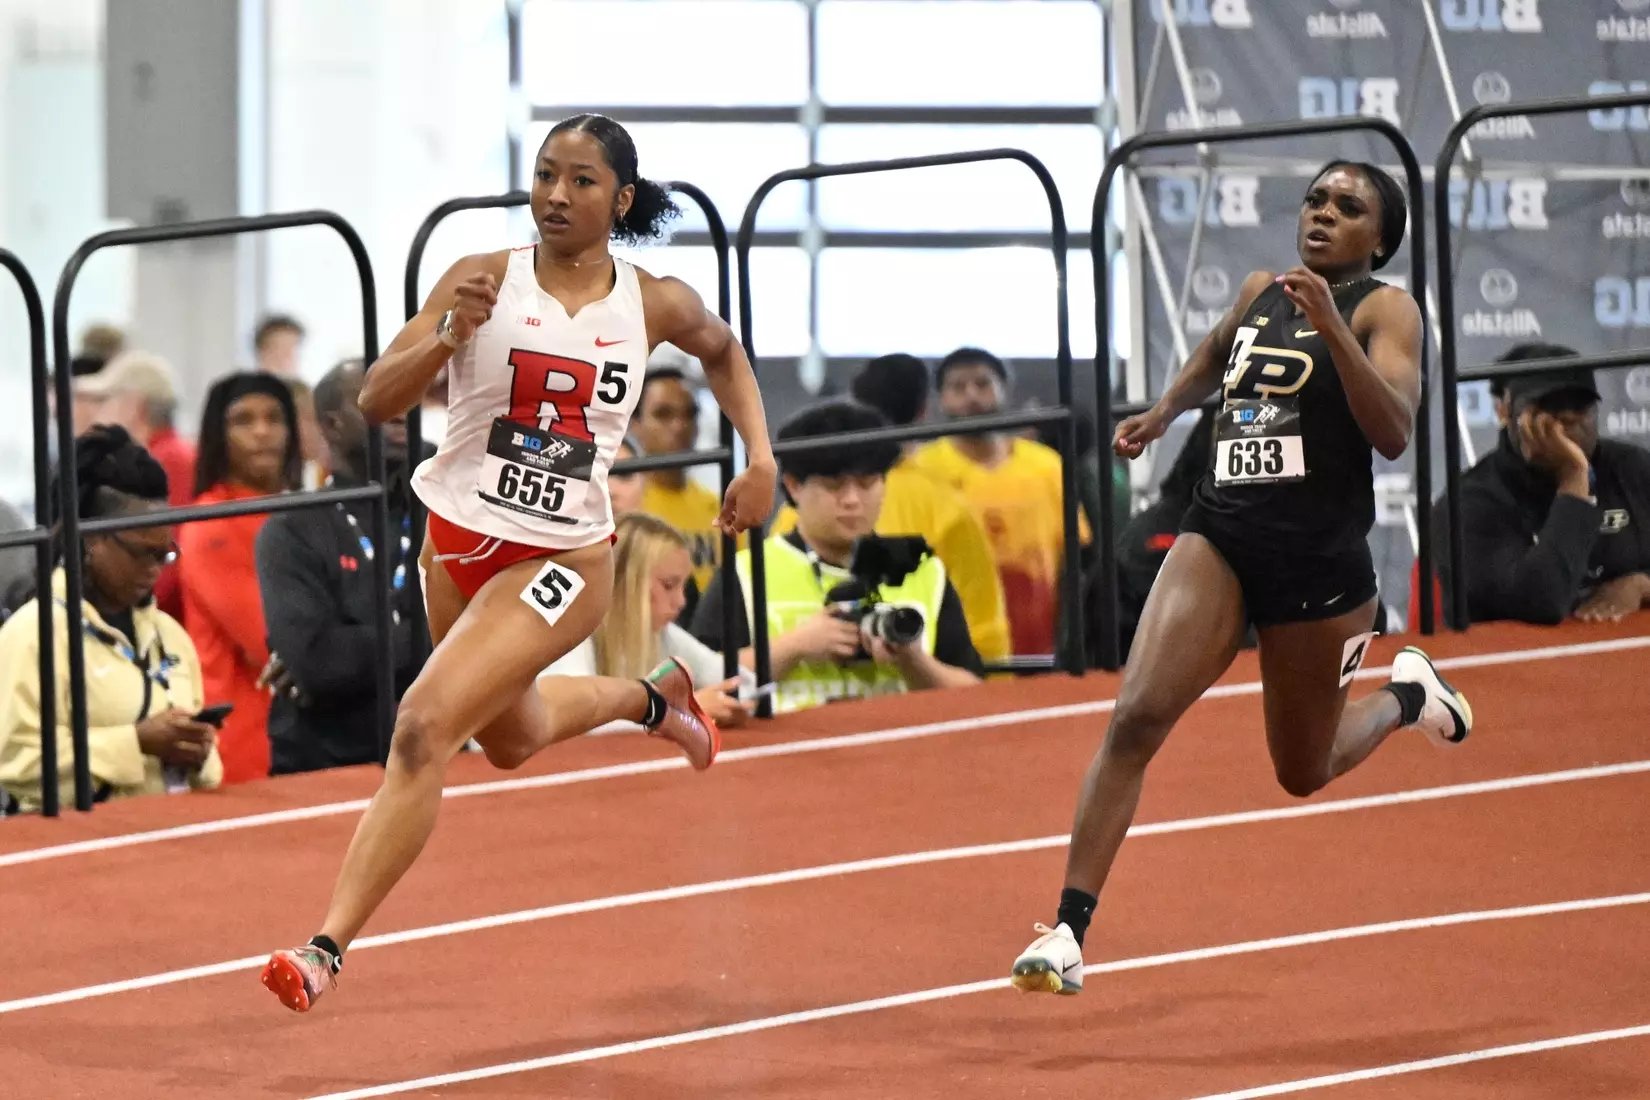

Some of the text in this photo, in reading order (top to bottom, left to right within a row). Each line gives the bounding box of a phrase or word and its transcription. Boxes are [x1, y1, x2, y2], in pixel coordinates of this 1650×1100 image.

[508, 347, 597, 444] R
[597, 361, 628, 404] 5
[1228, 439, 1283, 477] 633
[497, 463, 566, 512] 655
[531, 568, 573, 610] 5
[1341, 640, 1366, 677] 4
